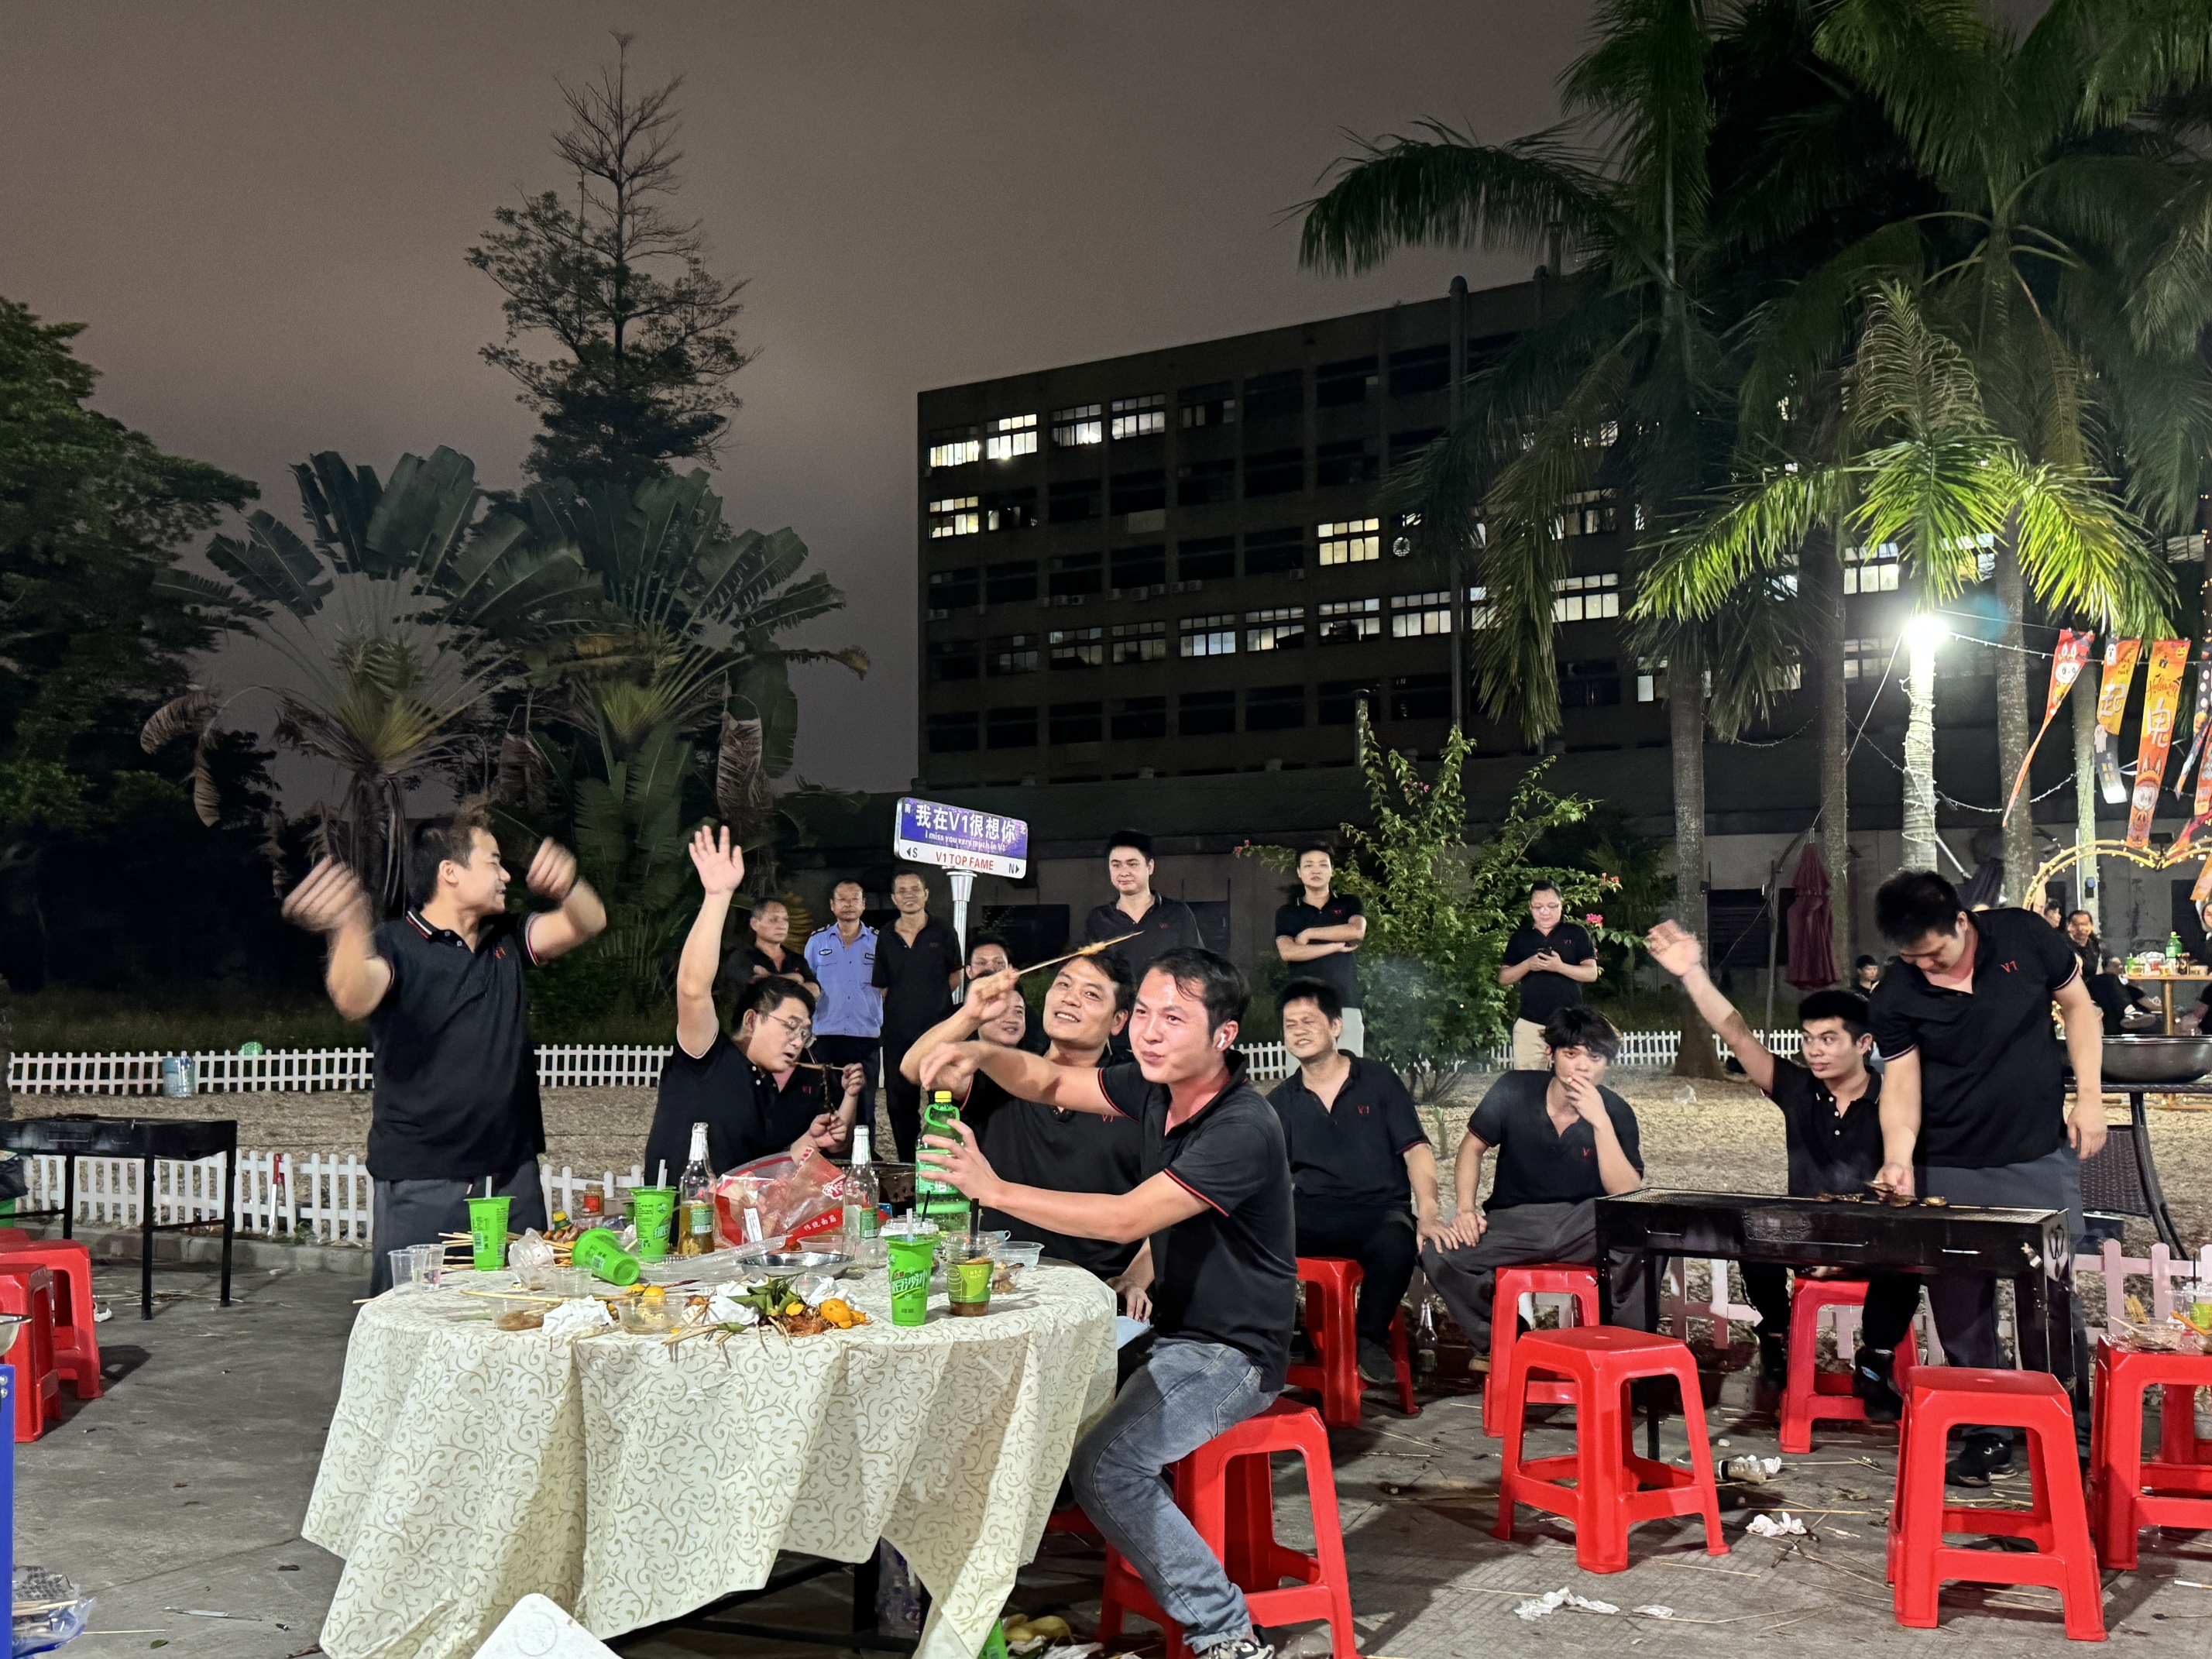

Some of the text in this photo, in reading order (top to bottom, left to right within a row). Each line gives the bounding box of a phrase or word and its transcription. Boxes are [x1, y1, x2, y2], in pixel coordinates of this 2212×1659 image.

[915, 804, 1015, 843] 我在V1很想你
[925, 830, 928, 839] I
[929, 832, 944, 841] miss
[945, 836, 957, 844] you
[958, 838, 972, 847] very
[973, 839, 990, 850] much
[912, 847, 918, 858] S
[936, 851, 994, 871] V1 TOP FAME
[1008, 863, 1015, 874] N
[2000, 960, 2019, 973] V1
[1358, 1105, 1369, 1115] V1
